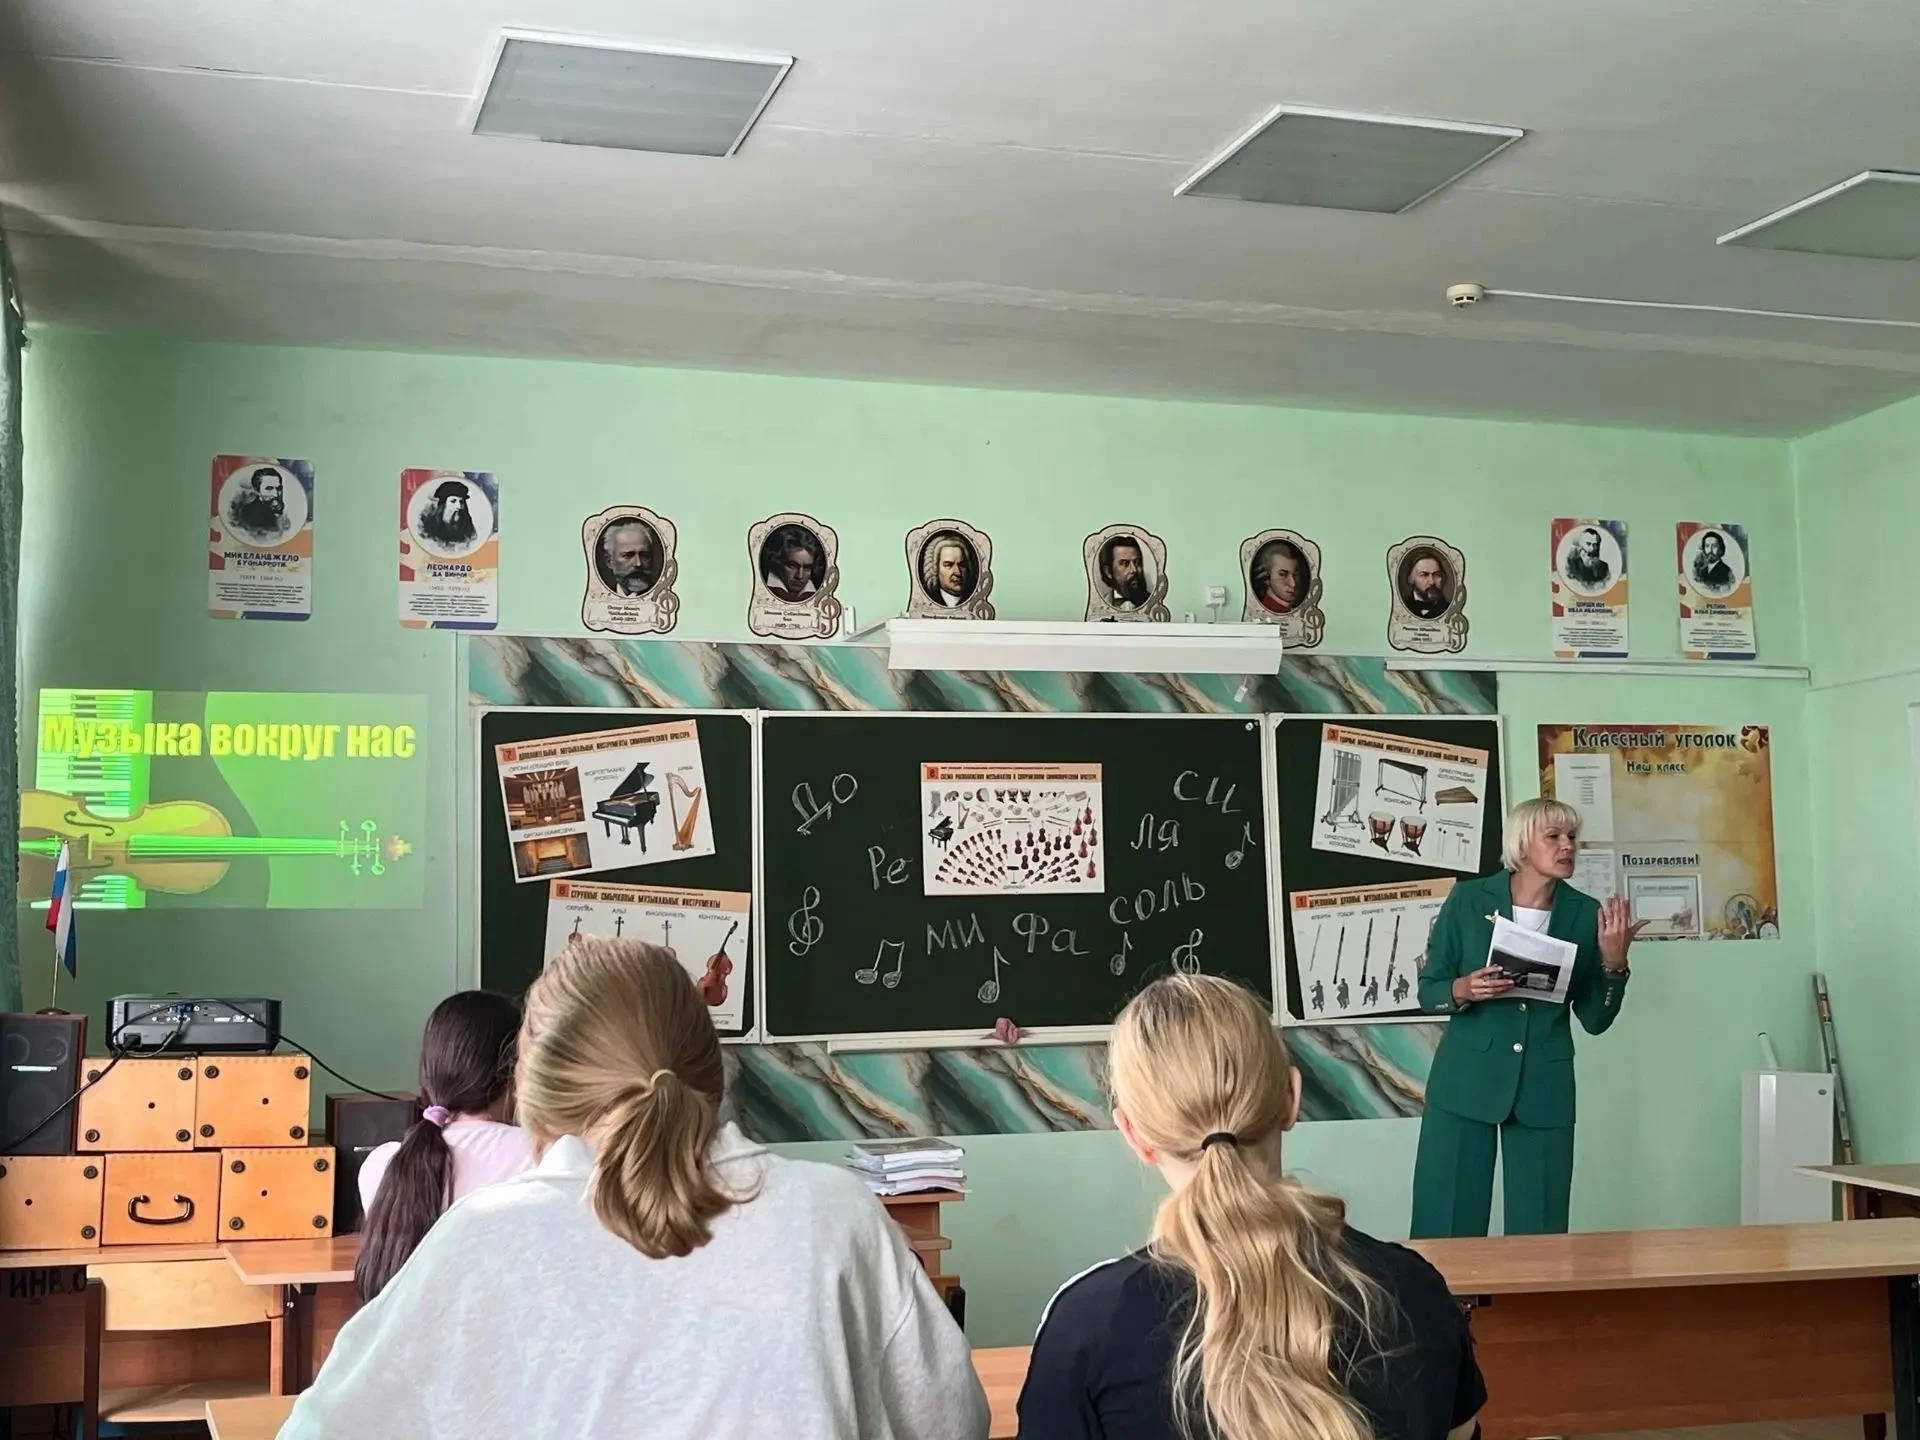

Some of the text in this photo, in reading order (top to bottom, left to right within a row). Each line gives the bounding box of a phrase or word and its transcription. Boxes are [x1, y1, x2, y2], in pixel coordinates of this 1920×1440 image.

[224, 552, 299, 562] МИКЕЛАНДЖЕЛО
[427, 564, 472, 572] ЛЕОНАРДО
[43, 715, 417, 761] Музыка вокруг нас
[1012, 912, 1091, 955] Фа
